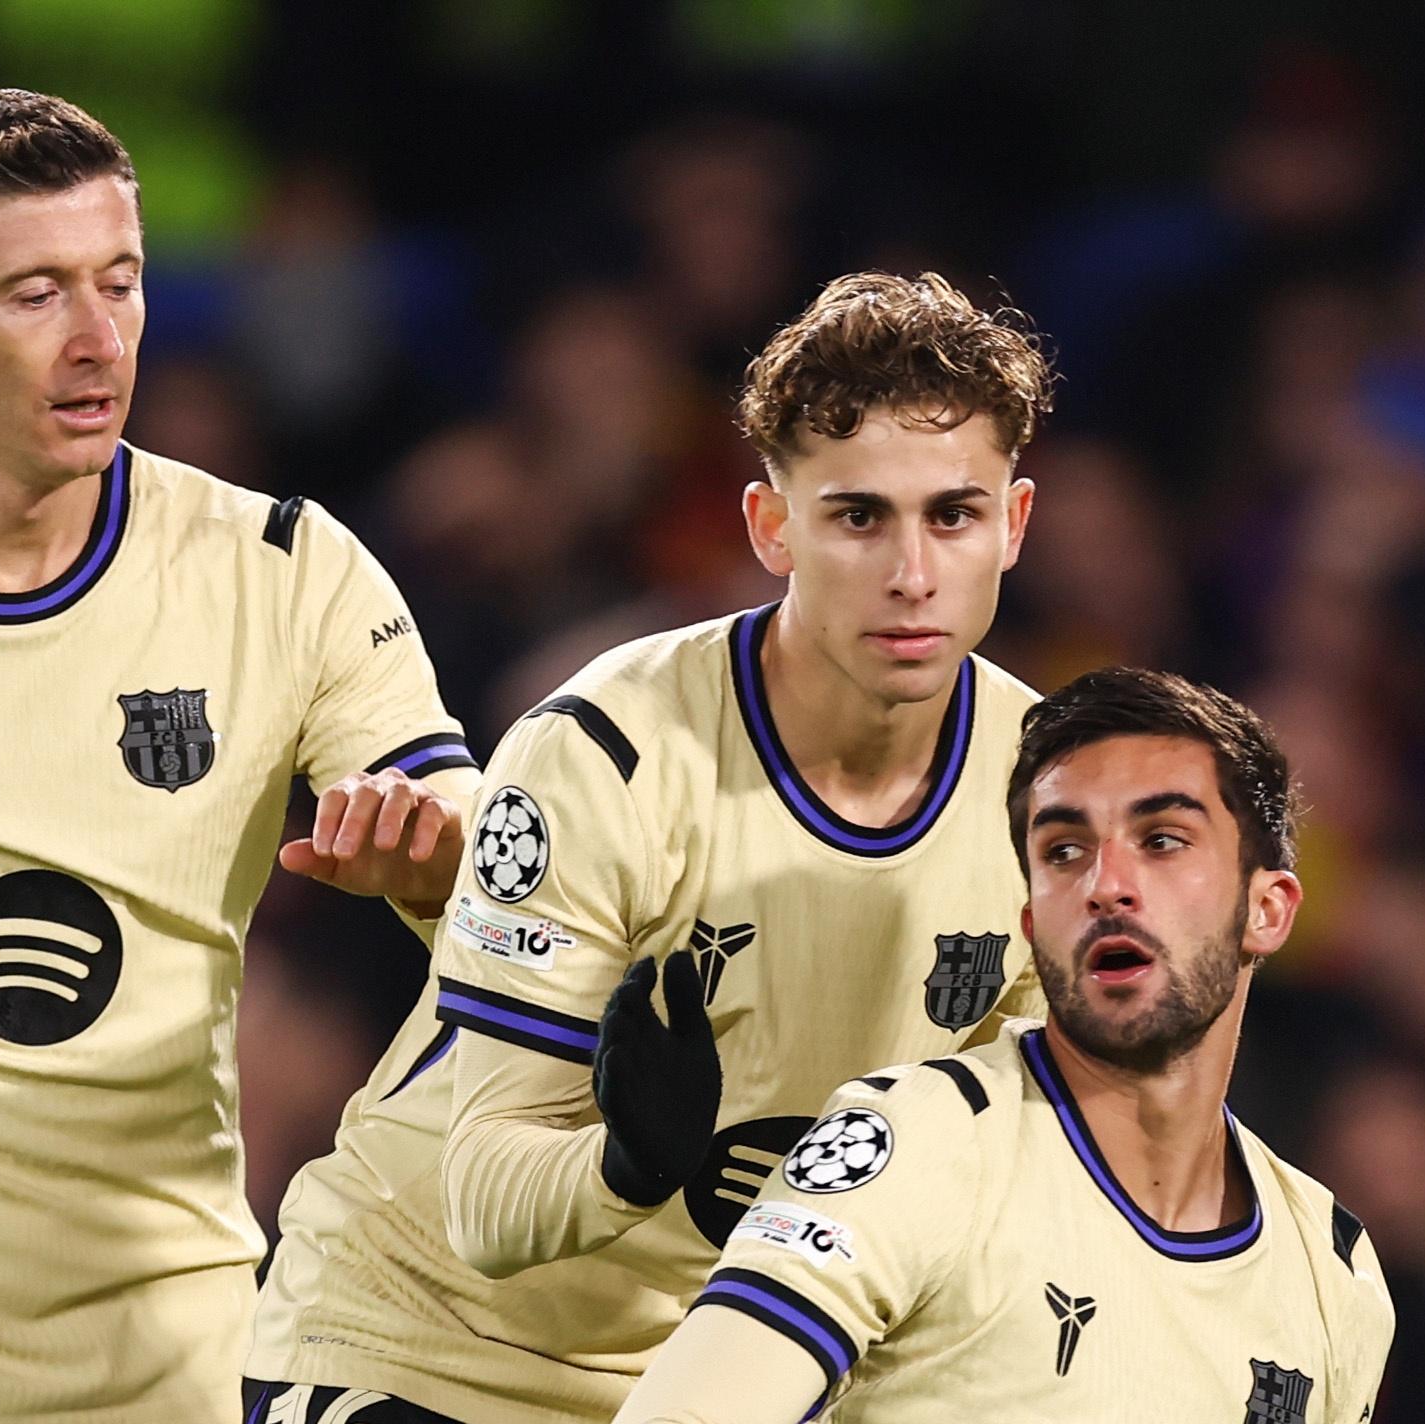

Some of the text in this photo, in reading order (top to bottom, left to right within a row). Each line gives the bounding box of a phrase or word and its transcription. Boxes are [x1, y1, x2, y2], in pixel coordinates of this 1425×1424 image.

[496, 822, 521, 864] 5
[514, 926, 552, 956] 10
[798, 1221, 835, 1253] 10
